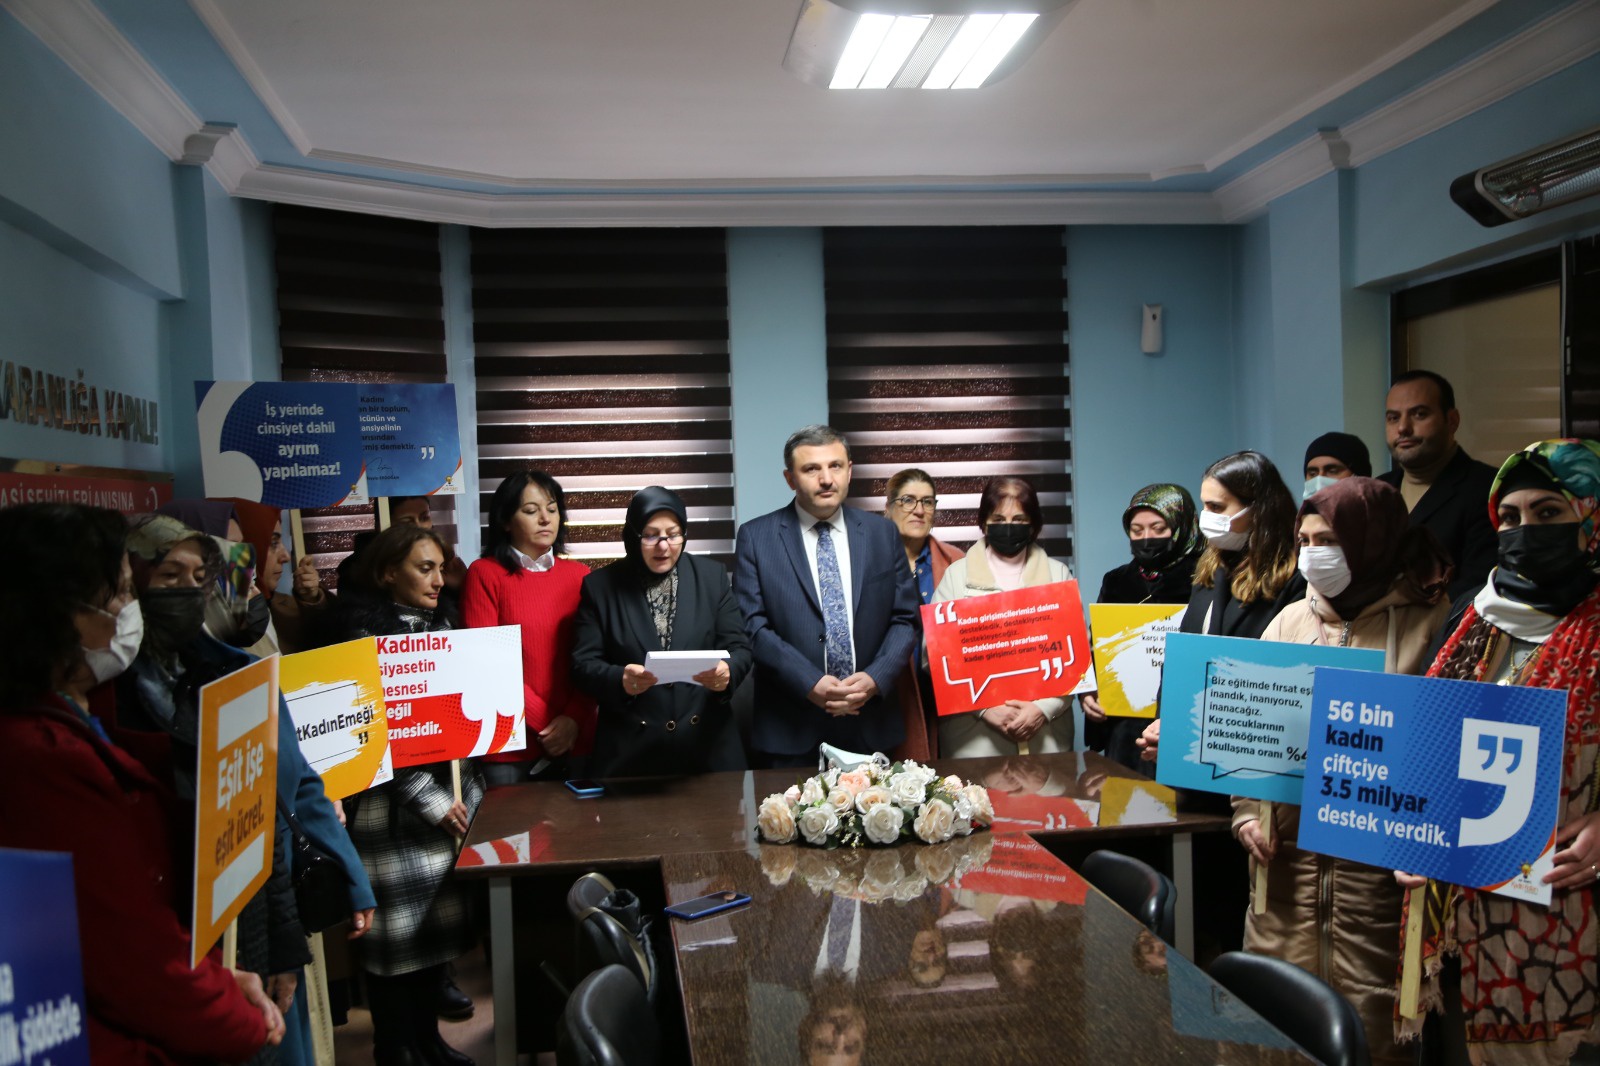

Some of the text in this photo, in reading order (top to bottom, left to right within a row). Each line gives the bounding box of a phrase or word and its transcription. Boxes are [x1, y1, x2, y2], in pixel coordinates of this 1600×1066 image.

[0, 360, 101, 436] ARANLIĞA
[265, 401, 324, 418] İş yerinde
[257, 421, 336, 436] cinsiyet dahil
[360, 424, 402, 432] ansiyelinin
[278, 444, 319, 458] ayrım
[262, 461, 341, 481] yapılamaz!
[957, 603, 1060, 626] Kadın girişimcilerimizi daima
[376, 634, 452, 654] Kadınlar,
[961, 634, 1048, 654] Desteklerden yararlanan
[1142, 635, 1158, 643] karşı
[963, 653, 984, 663] kadın
[985, 649, 1017, 661] girişimci
[1038, 641, 1063, 654] %41
[1211, 676, 1226, 686] Biz
[1228, 678, 1270, 690] eğitimde
[1272, 682, 1297, 694] fırsat
[1209, 701, 1263, 716] inanacağız.
[1210, 689, 1303, 709] inandık, inanıyoruz,
[385, 702, 412, 721] eğil
[1327, 699, 1394, 728] 56 bin
[1208, 714, 1285, 732] Kız çocuklarının
[1207, 728, 1280, 745] yükseköğretim
[1325, 724, 1384, 752] kadın
[1206, 741, 1255, 755] okullaşma
[1257, 749, 1283, 759] oranı
[216, 738, 264, 812] Eşit işe
[1322, 753, 1389, 782] çiftçiye
[1320, 775, 1428, 813] 3.5 milyar
[215, 794, 265, 867] eşit ücret.
[1317, 803, 1451, 848] destek verdik.
